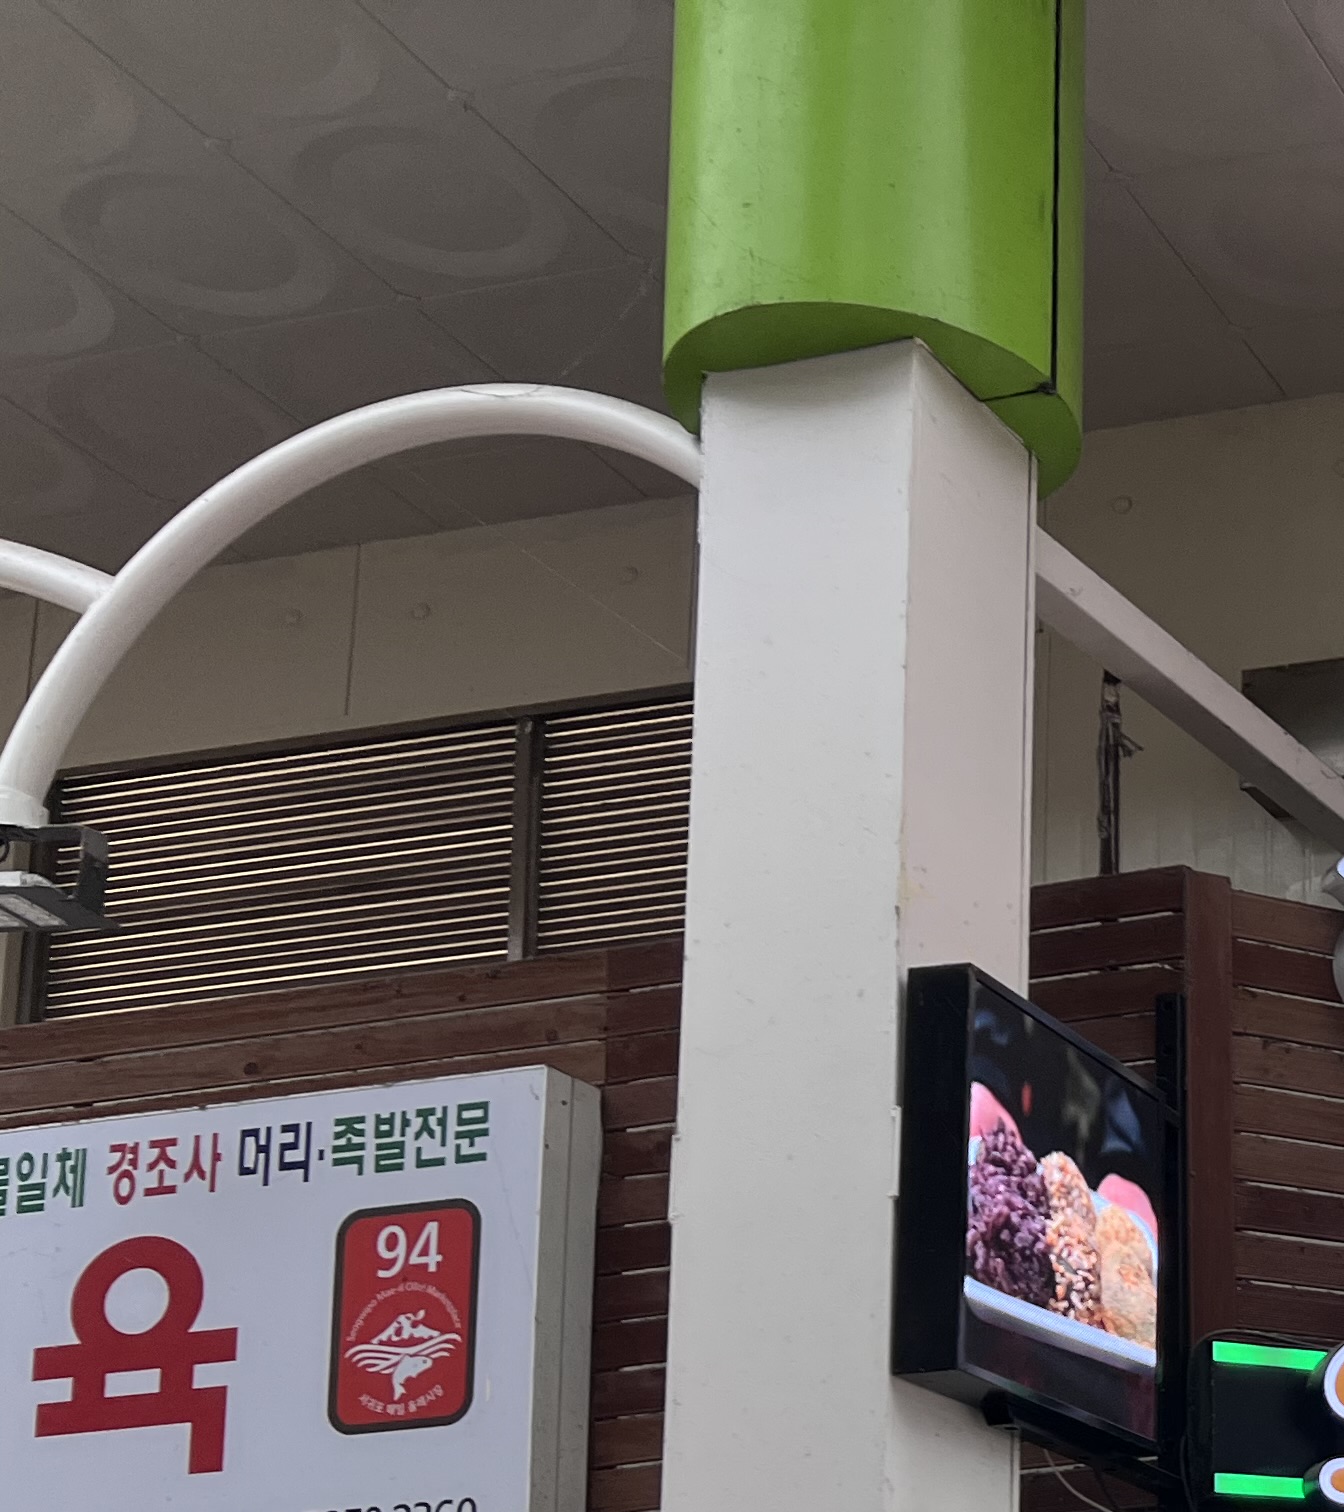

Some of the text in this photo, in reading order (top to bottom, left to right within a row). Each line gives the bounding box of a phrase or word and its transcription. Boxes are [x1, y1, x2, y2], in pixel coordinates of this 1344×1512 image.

[106, 1132, 222, 1205] 경조사
[376, 1221, 443, 1278] 94
[32, 1235, 238, 1475] 육
